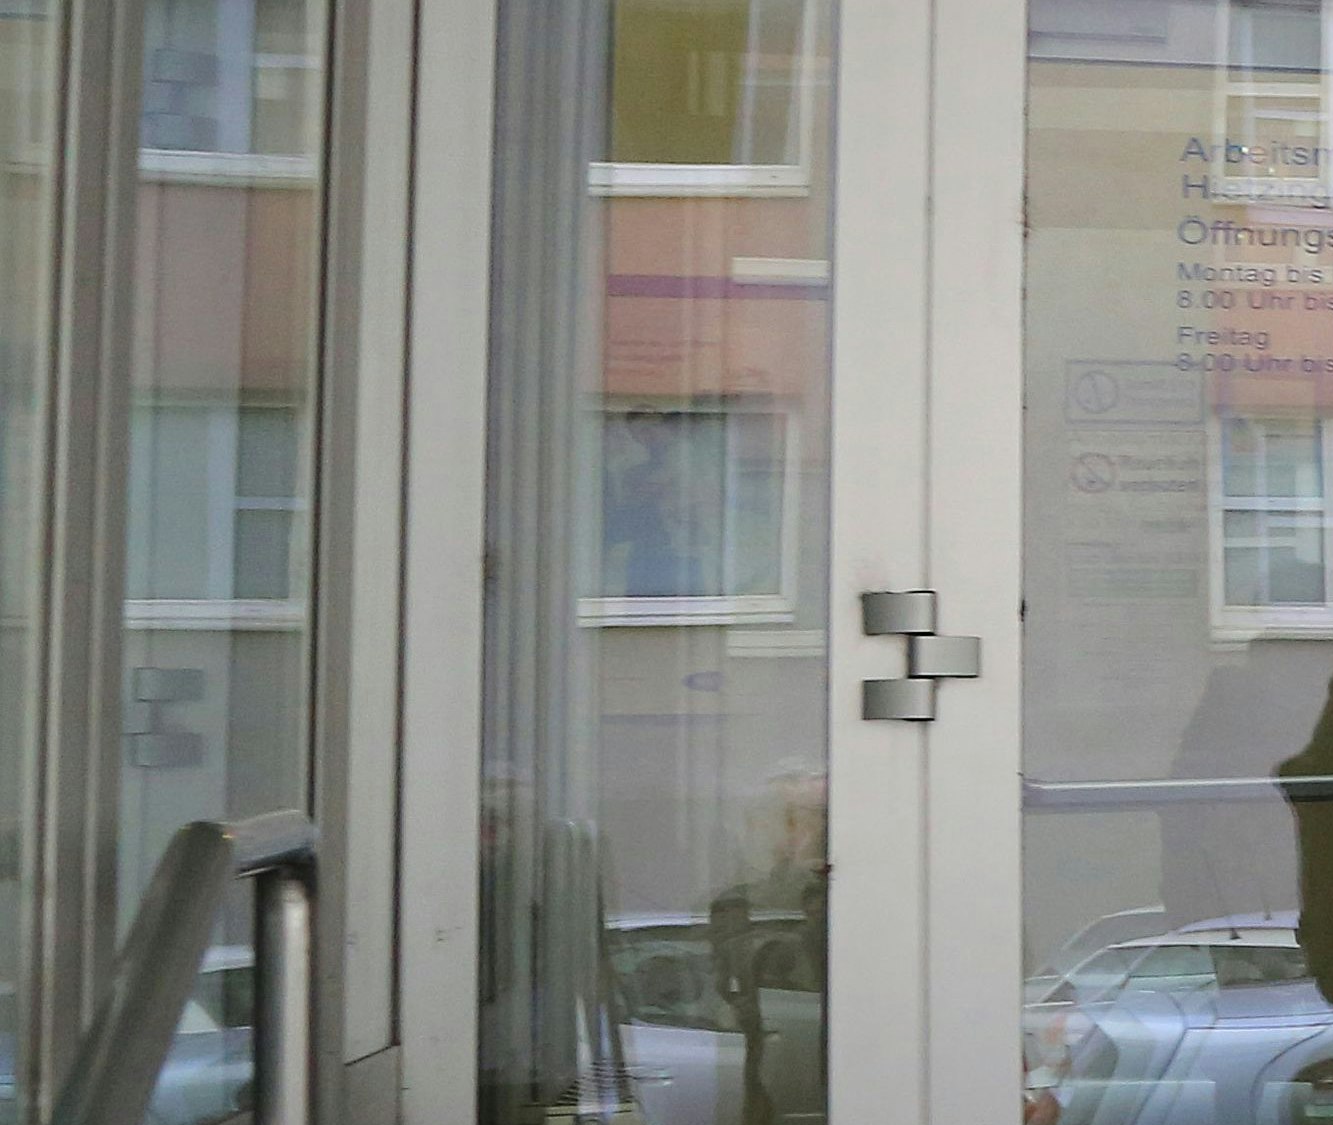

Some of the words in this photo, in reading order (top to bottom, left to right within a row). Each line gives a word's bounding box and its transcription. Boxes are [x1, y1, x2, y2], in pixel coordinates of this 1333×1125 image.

[1177, 262, 1276, 287] Montag
[1286, 264, 1324, 284] bis
[1178, 325, 1270, 350] Freitag
